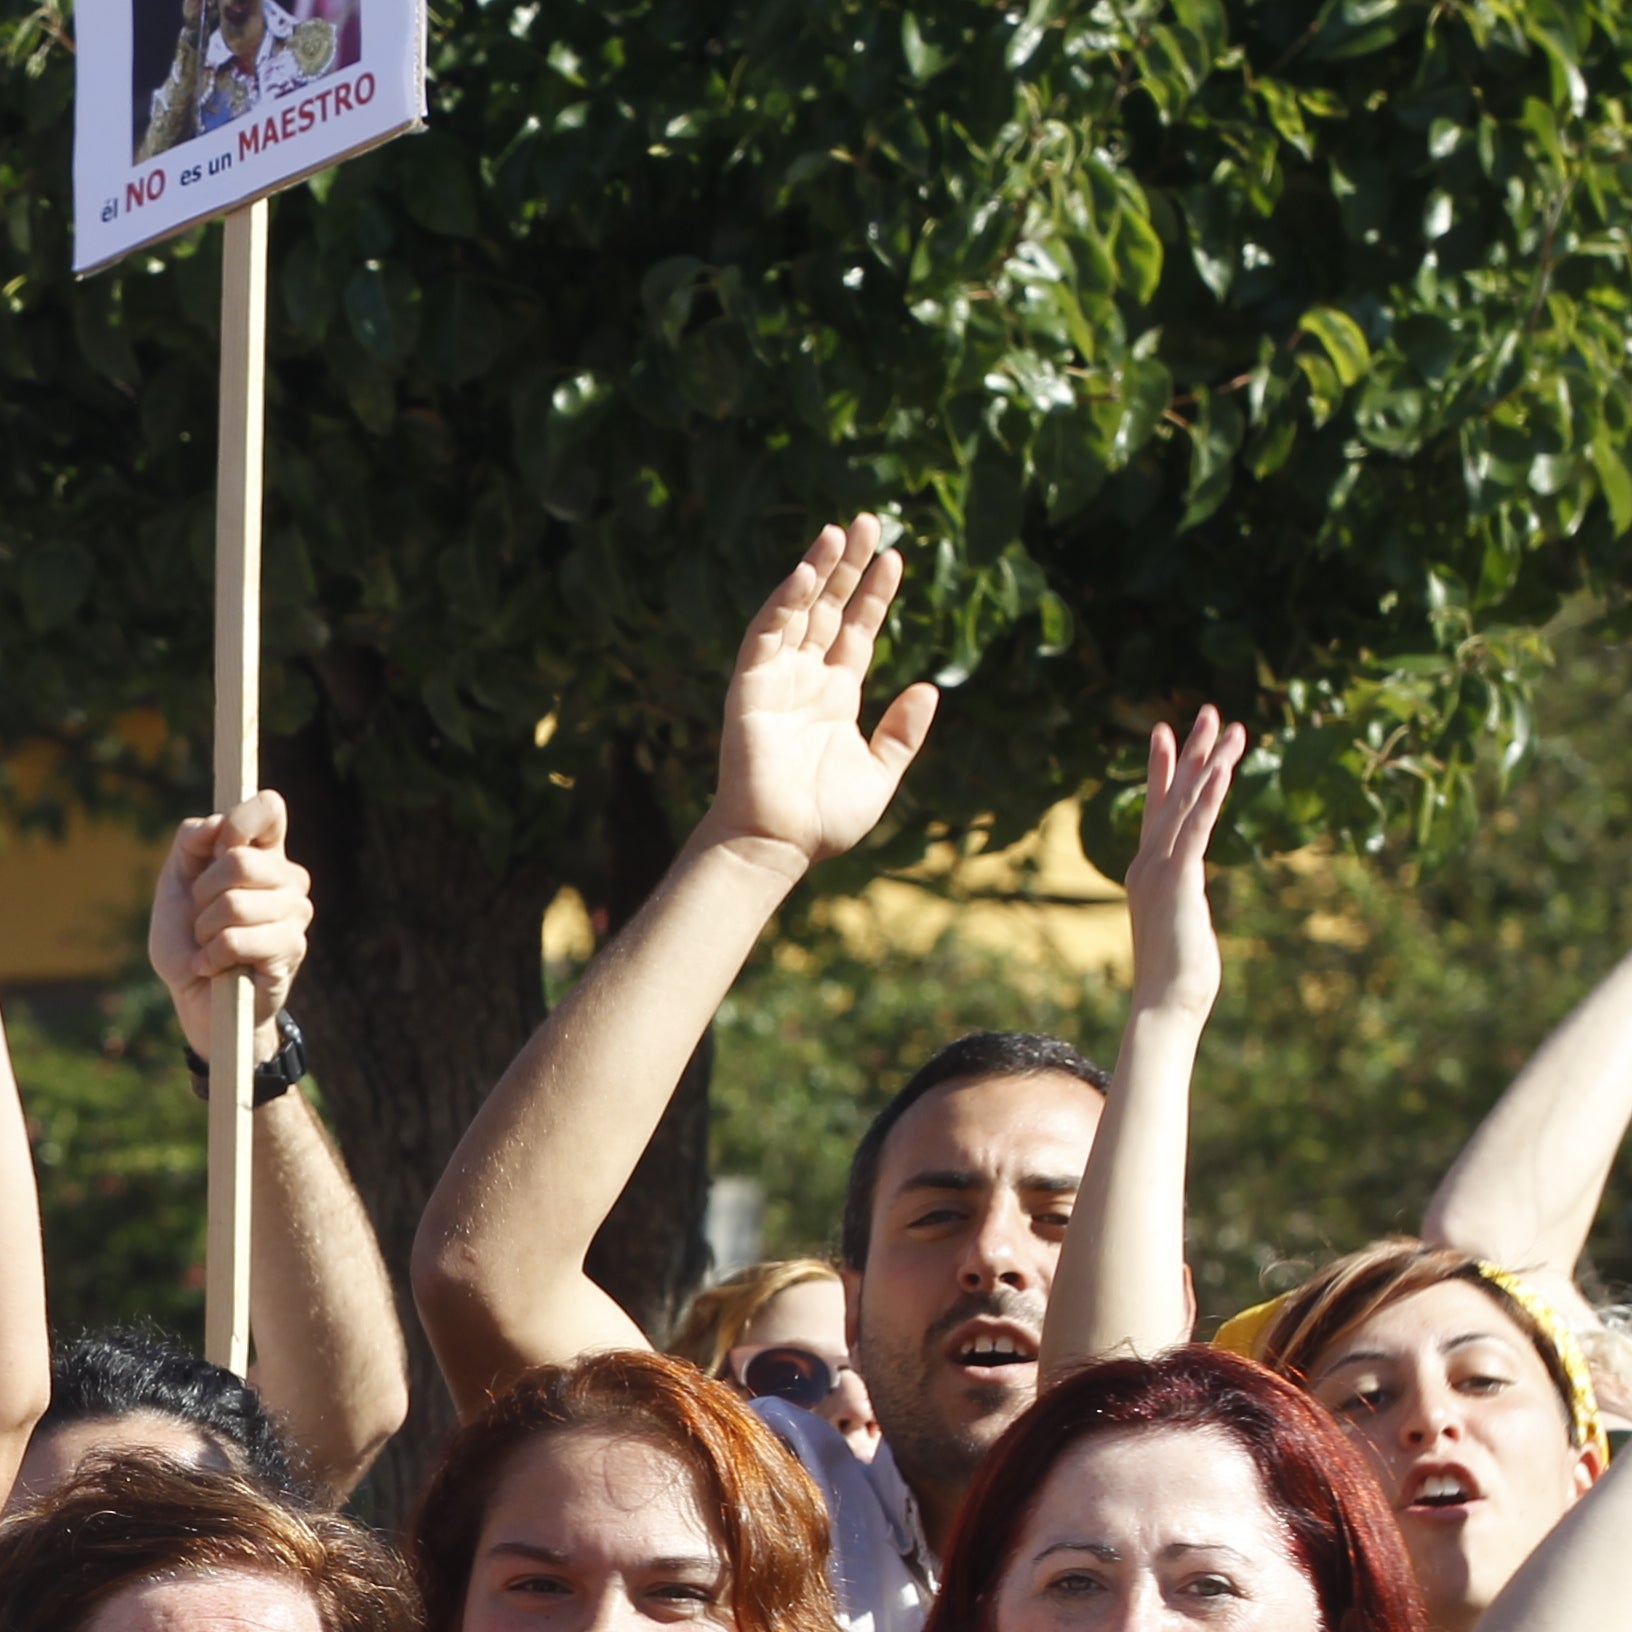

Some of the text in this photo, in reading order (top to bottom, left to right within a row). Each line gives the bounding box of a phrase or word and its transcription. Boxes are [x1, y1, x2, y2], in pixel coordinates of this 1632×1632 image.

[100, 71, 376, 222] él NO es un MAESTRO
